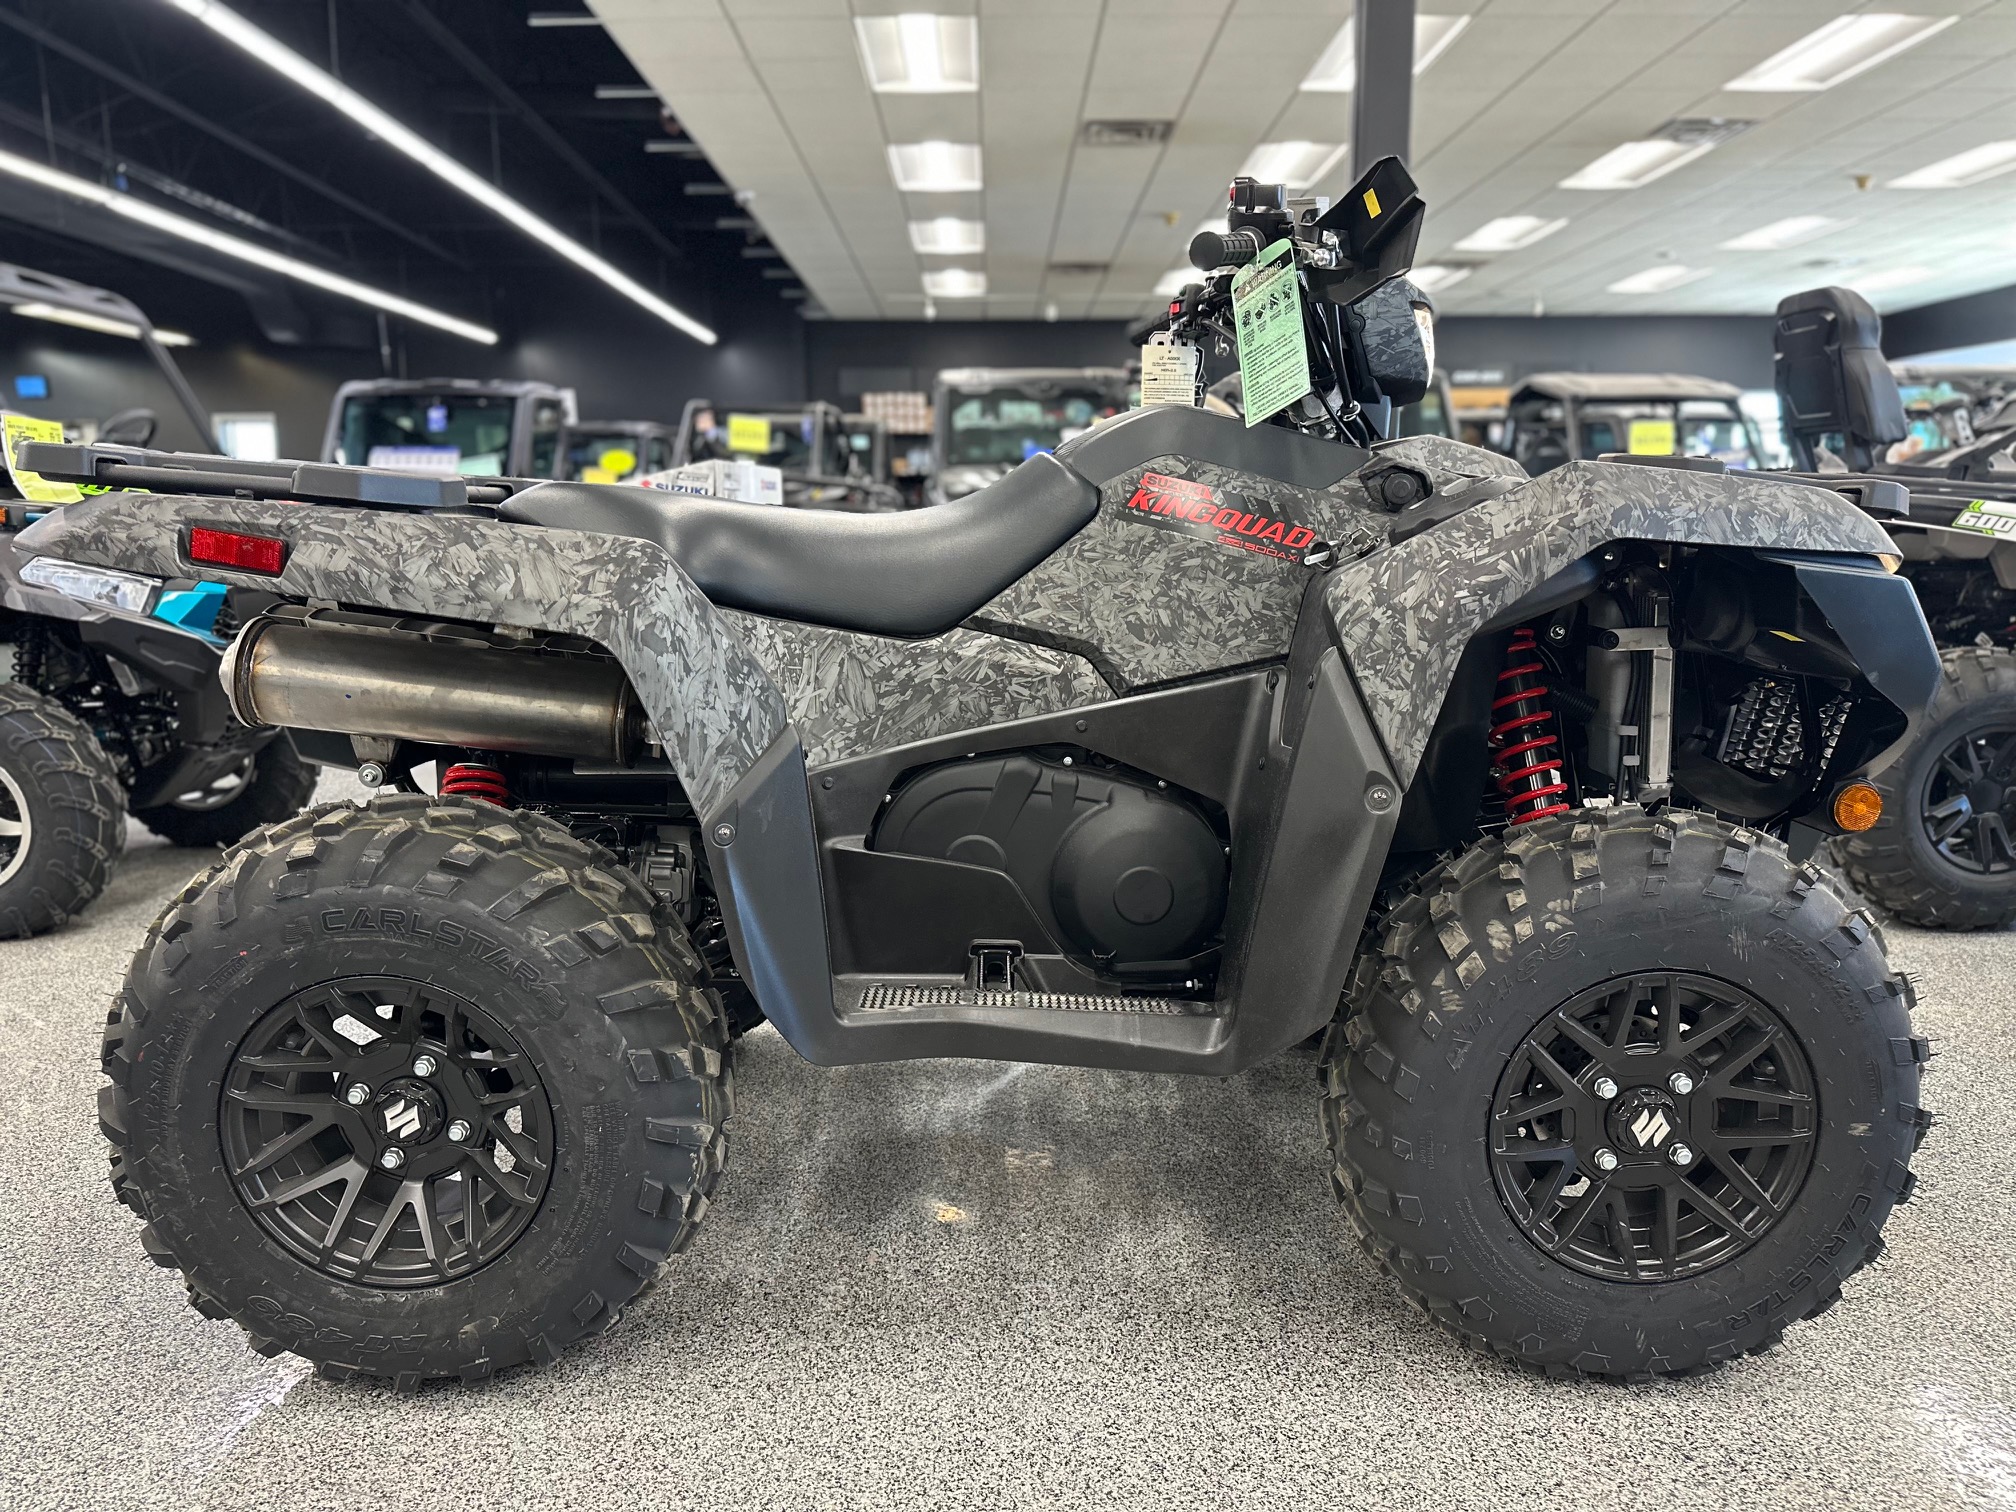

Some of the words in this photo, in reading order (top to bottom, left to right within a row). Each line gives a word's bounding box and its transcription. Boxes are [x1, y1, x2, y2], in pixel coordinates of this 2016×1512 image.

[1146, 474, 1206, 496] SUZUKI
[1127, 488, 1316, 549] KINGQUAD
[320, 907, 543, 989] CARLSTAR
[1727, 1195, 1872, 1335] CARLSTAR
[248, 1293, 428, 1354] AT489
